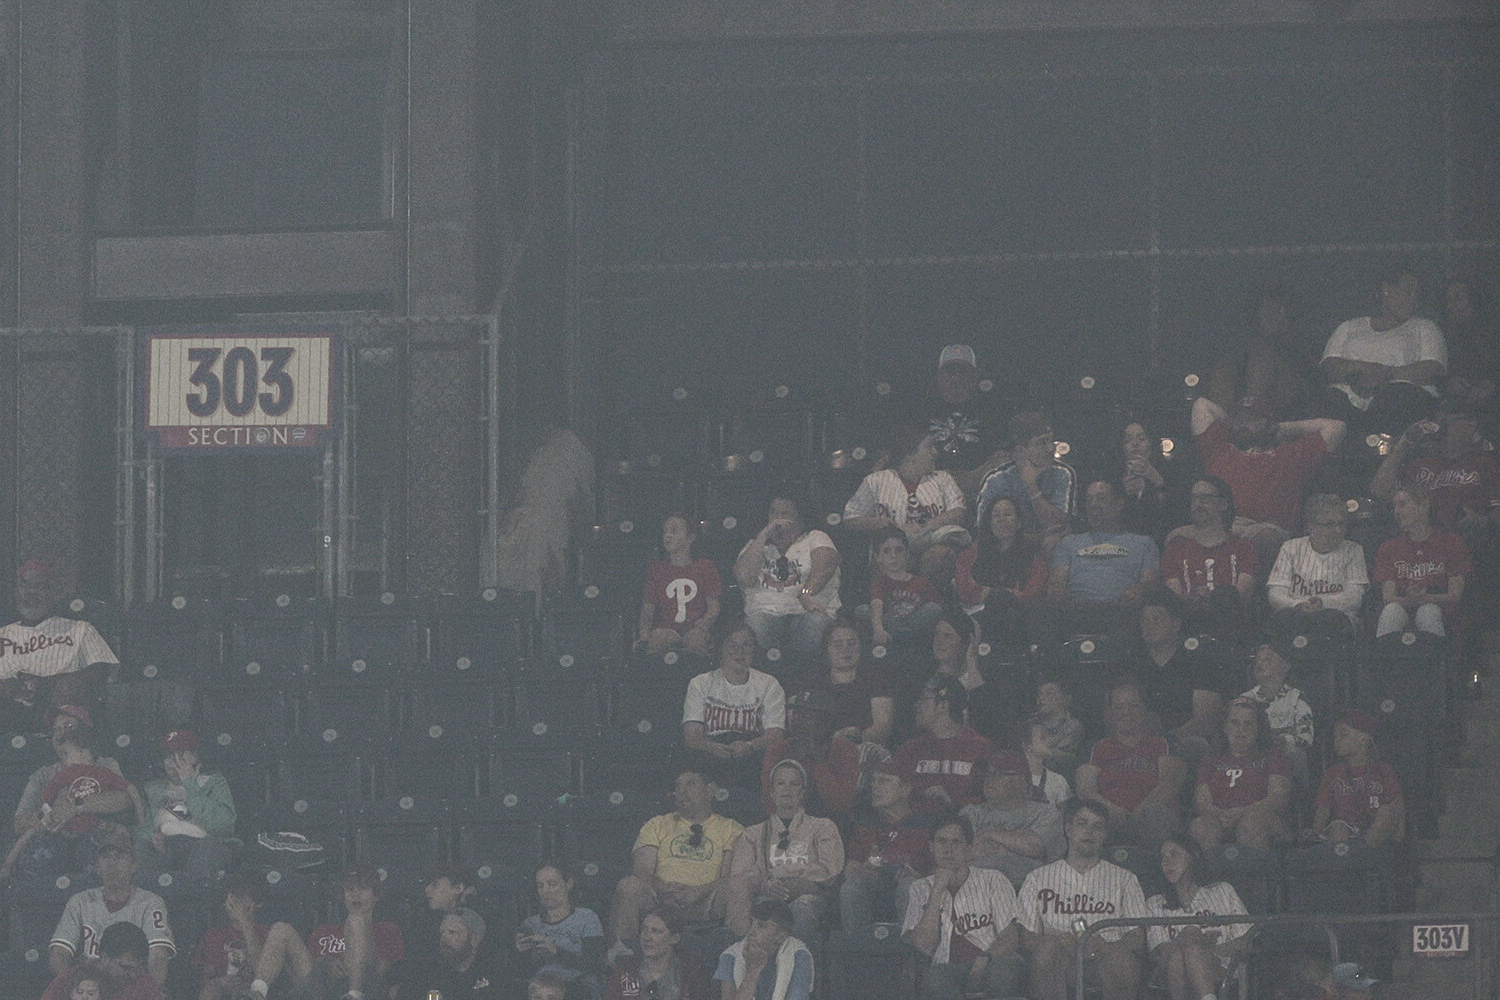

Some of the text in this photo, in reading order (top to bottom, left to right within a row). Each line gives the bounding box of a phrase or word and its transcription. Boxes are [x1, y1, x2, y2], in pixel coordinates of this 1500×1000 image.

[186, 347, 294, 418] 303
[188, 428, 289, 447] SECTION
[1292, 574, 1344, 595] Phillies
[666, 578, 698, 623] P
[1226, 769, 1243, 788] P
[1037, 889, 1115, 916] Phillies
[1416, 926, 1468, 950] 303V
